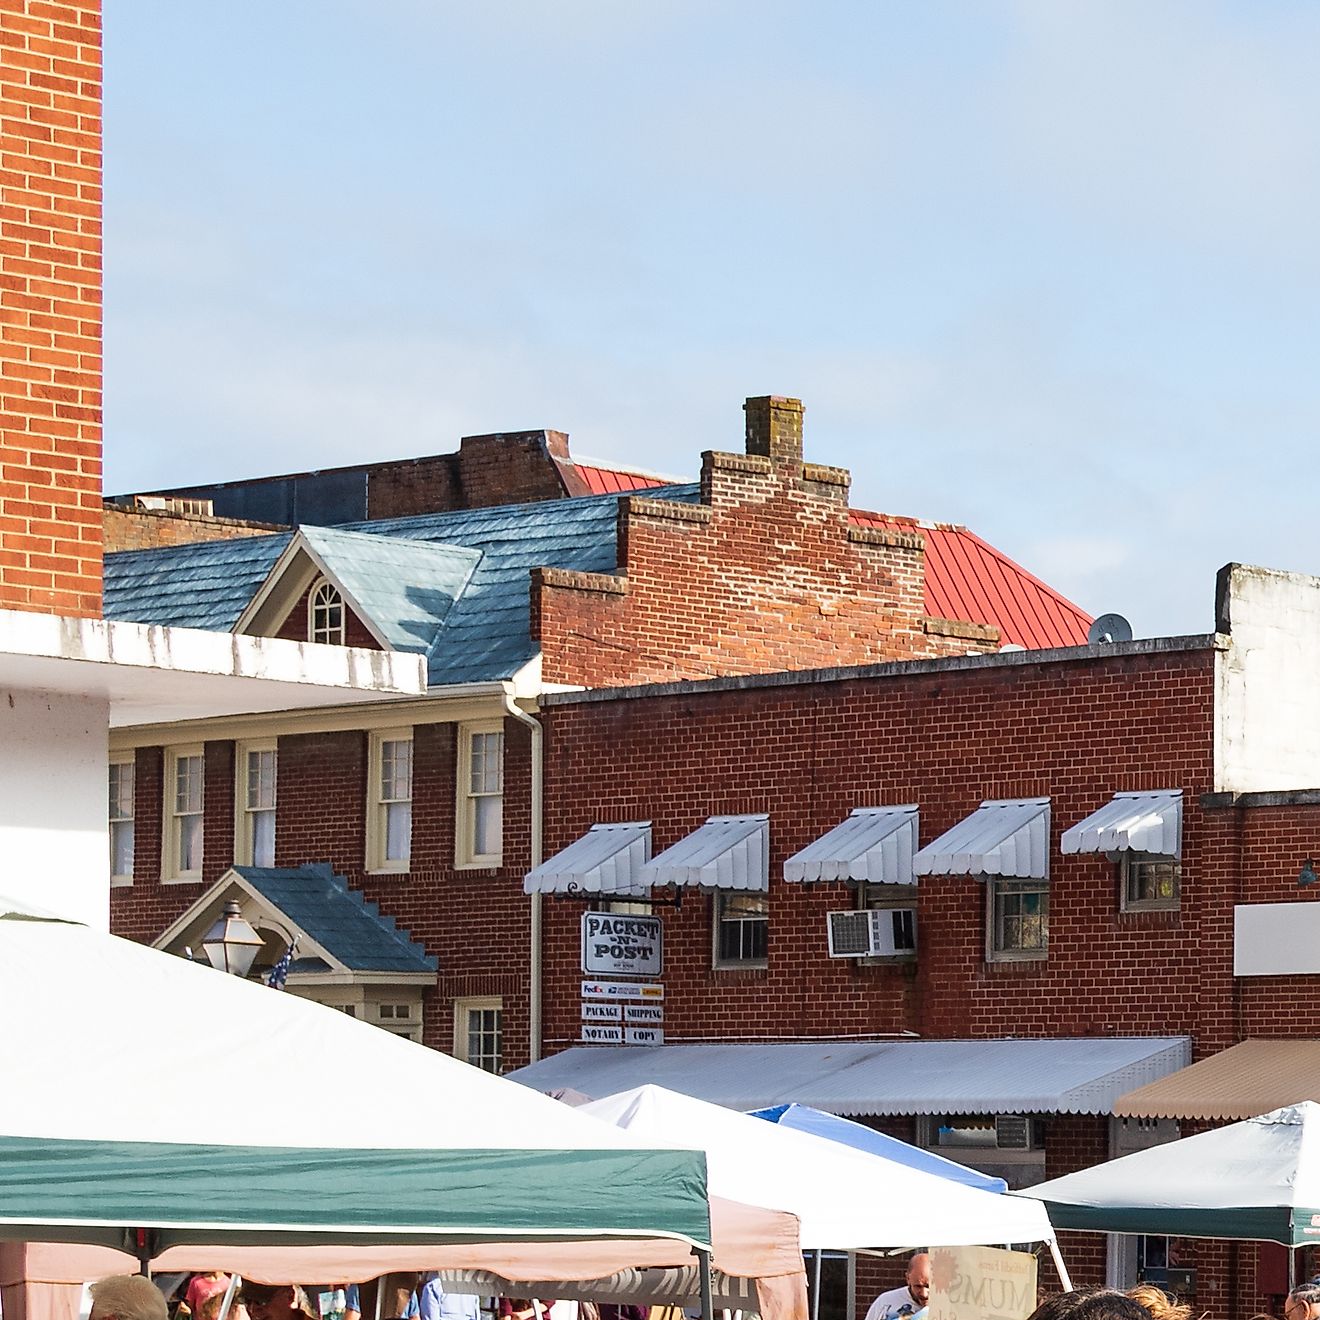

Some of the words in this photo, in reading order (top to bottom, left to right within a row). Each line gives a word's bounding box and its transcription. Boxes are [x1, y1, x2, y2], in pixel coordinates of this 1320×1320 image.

[588, 918, 659, 940] PACKET
[594, 944, 654, 960] POST
[584, 984, 603, 993] FedEx
[586, 1007, 618, 1017] PACKAGE
[627, 1009, 662, 1019] SHIPPING
[585, 1029, 620, 1039] NOTARY
[633, 1031, 655, 1041] COPY
